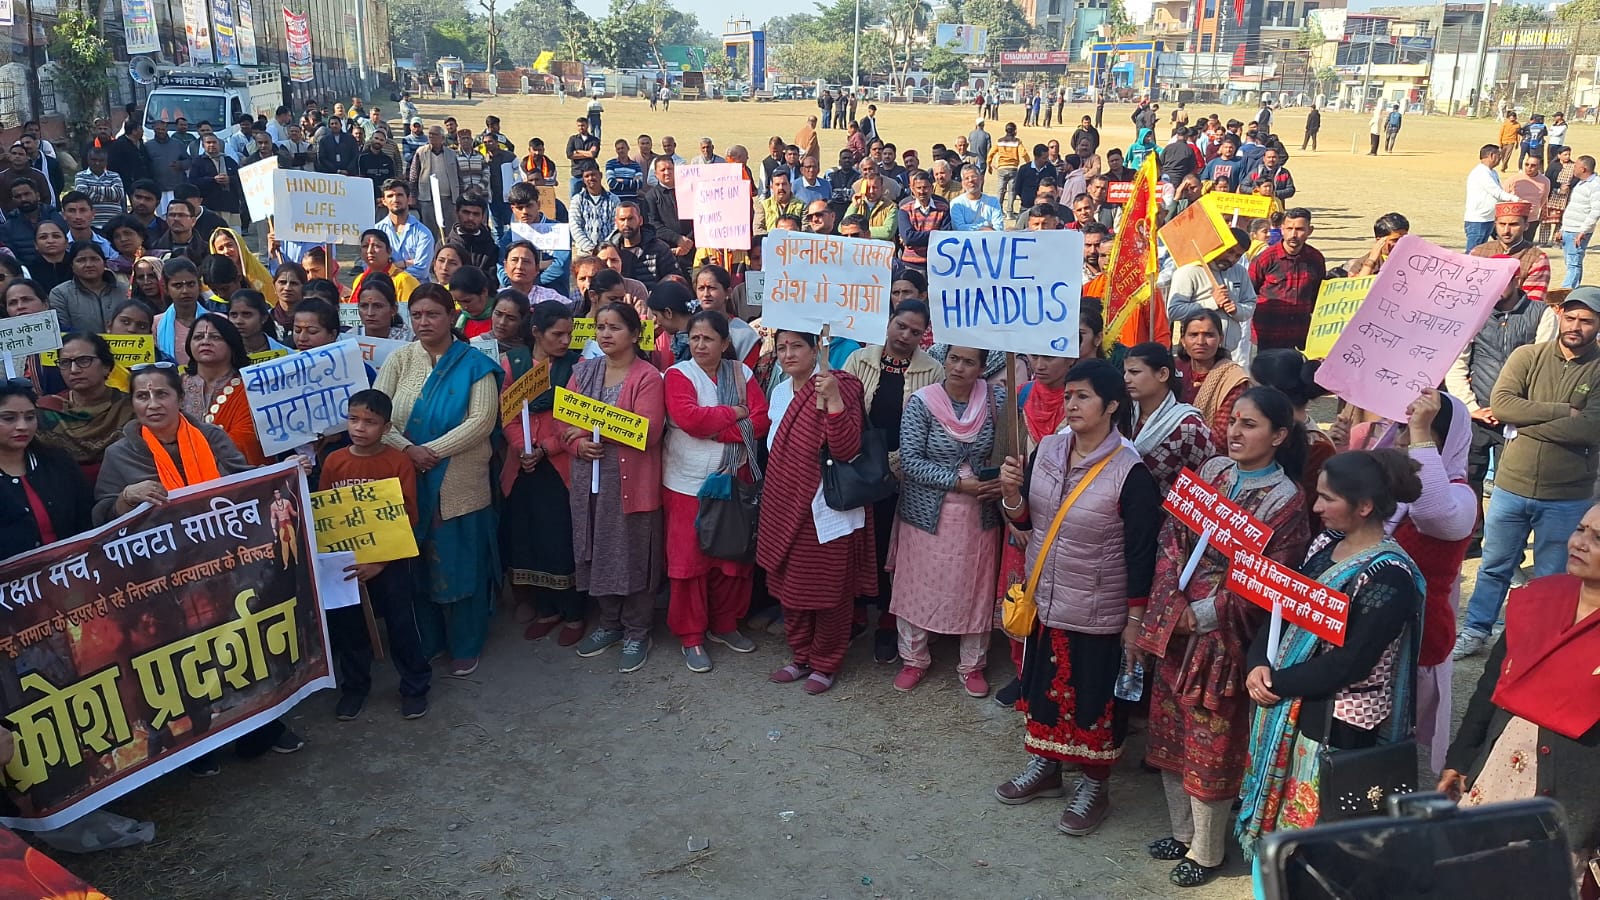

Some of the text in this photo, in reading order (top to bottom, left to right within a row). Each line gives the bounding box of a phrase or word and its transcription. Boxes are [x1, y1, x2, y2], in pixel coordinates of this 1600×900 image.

[286, 178, 346, 197] HINDUS
[681, 168, 700, 177] SAVE
[305, 201, 336, 217] LIFE
[294, 222, 360, 237] MATTERS
[931, 238, 1036, 280] SAVE
[1393, 270, 1408, 295] के
[942, 282, 1069, 328] HINDUS
[1378, 298, 1400, 320] पर
[1358, 322, 1403, 349] करना
[558, 406, 564, 415] न
[566, 409, 580, 420] मान
[636, 432, 644, 443] है
[563, 393, 642, 428] जीव का धर्म सनातन है
[181, 496, 263, 543] साहिब
[17, 620, 53, 647] समाज
[52, 610, 66, 631] के
[96, 594, 108, 614] हो
[109, 589, 126, 609] रहे
[171, 560, 222, 588] अत्याचार
[221, 549, 235, 570] के
[132, 588, 299, 730] प्रदर्शन
